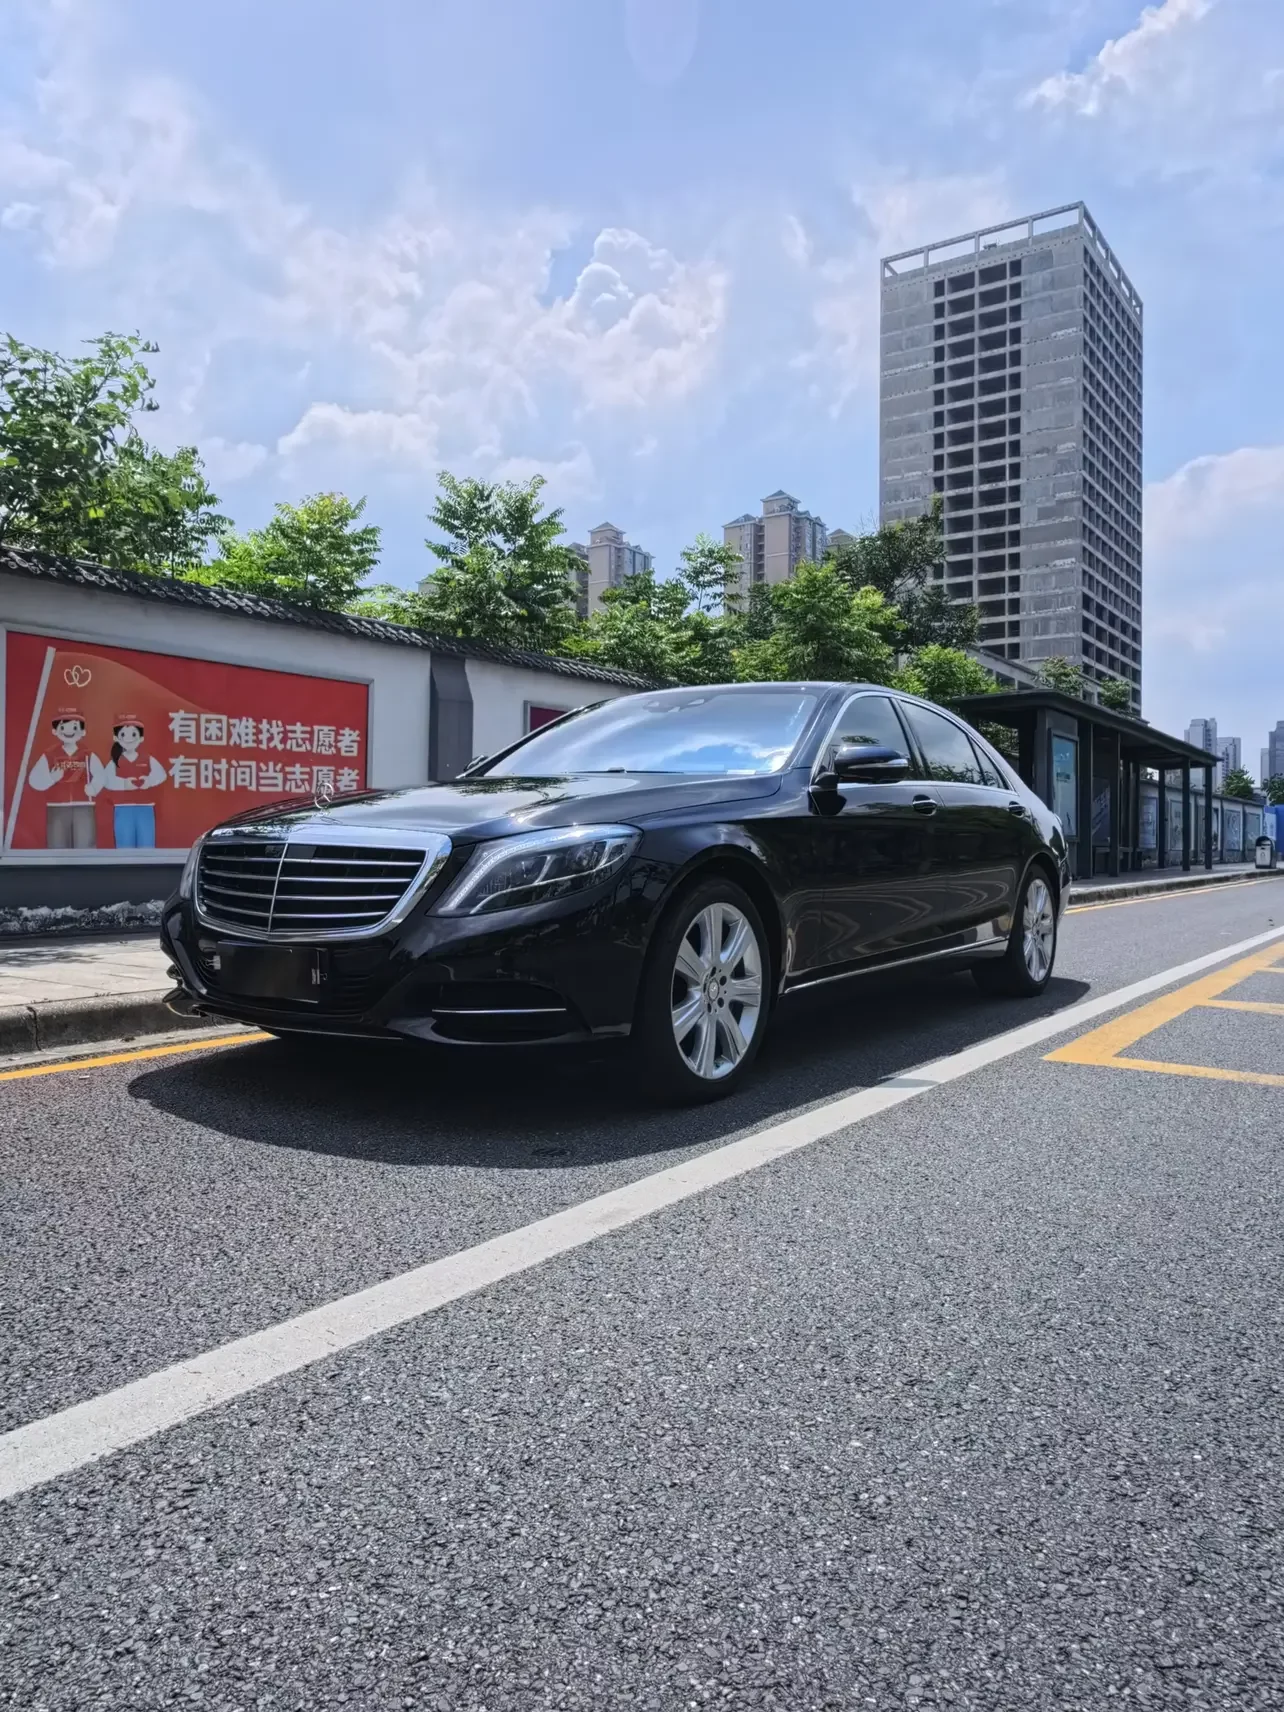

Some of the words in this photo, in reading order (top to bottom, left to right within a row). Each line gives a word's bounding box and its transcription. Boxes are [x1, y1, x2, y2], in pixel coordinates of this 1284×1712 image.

[168, 709, 361, 757] 有困难找志愿者
[168, 755, 360, 794] 有时间当志愿者
